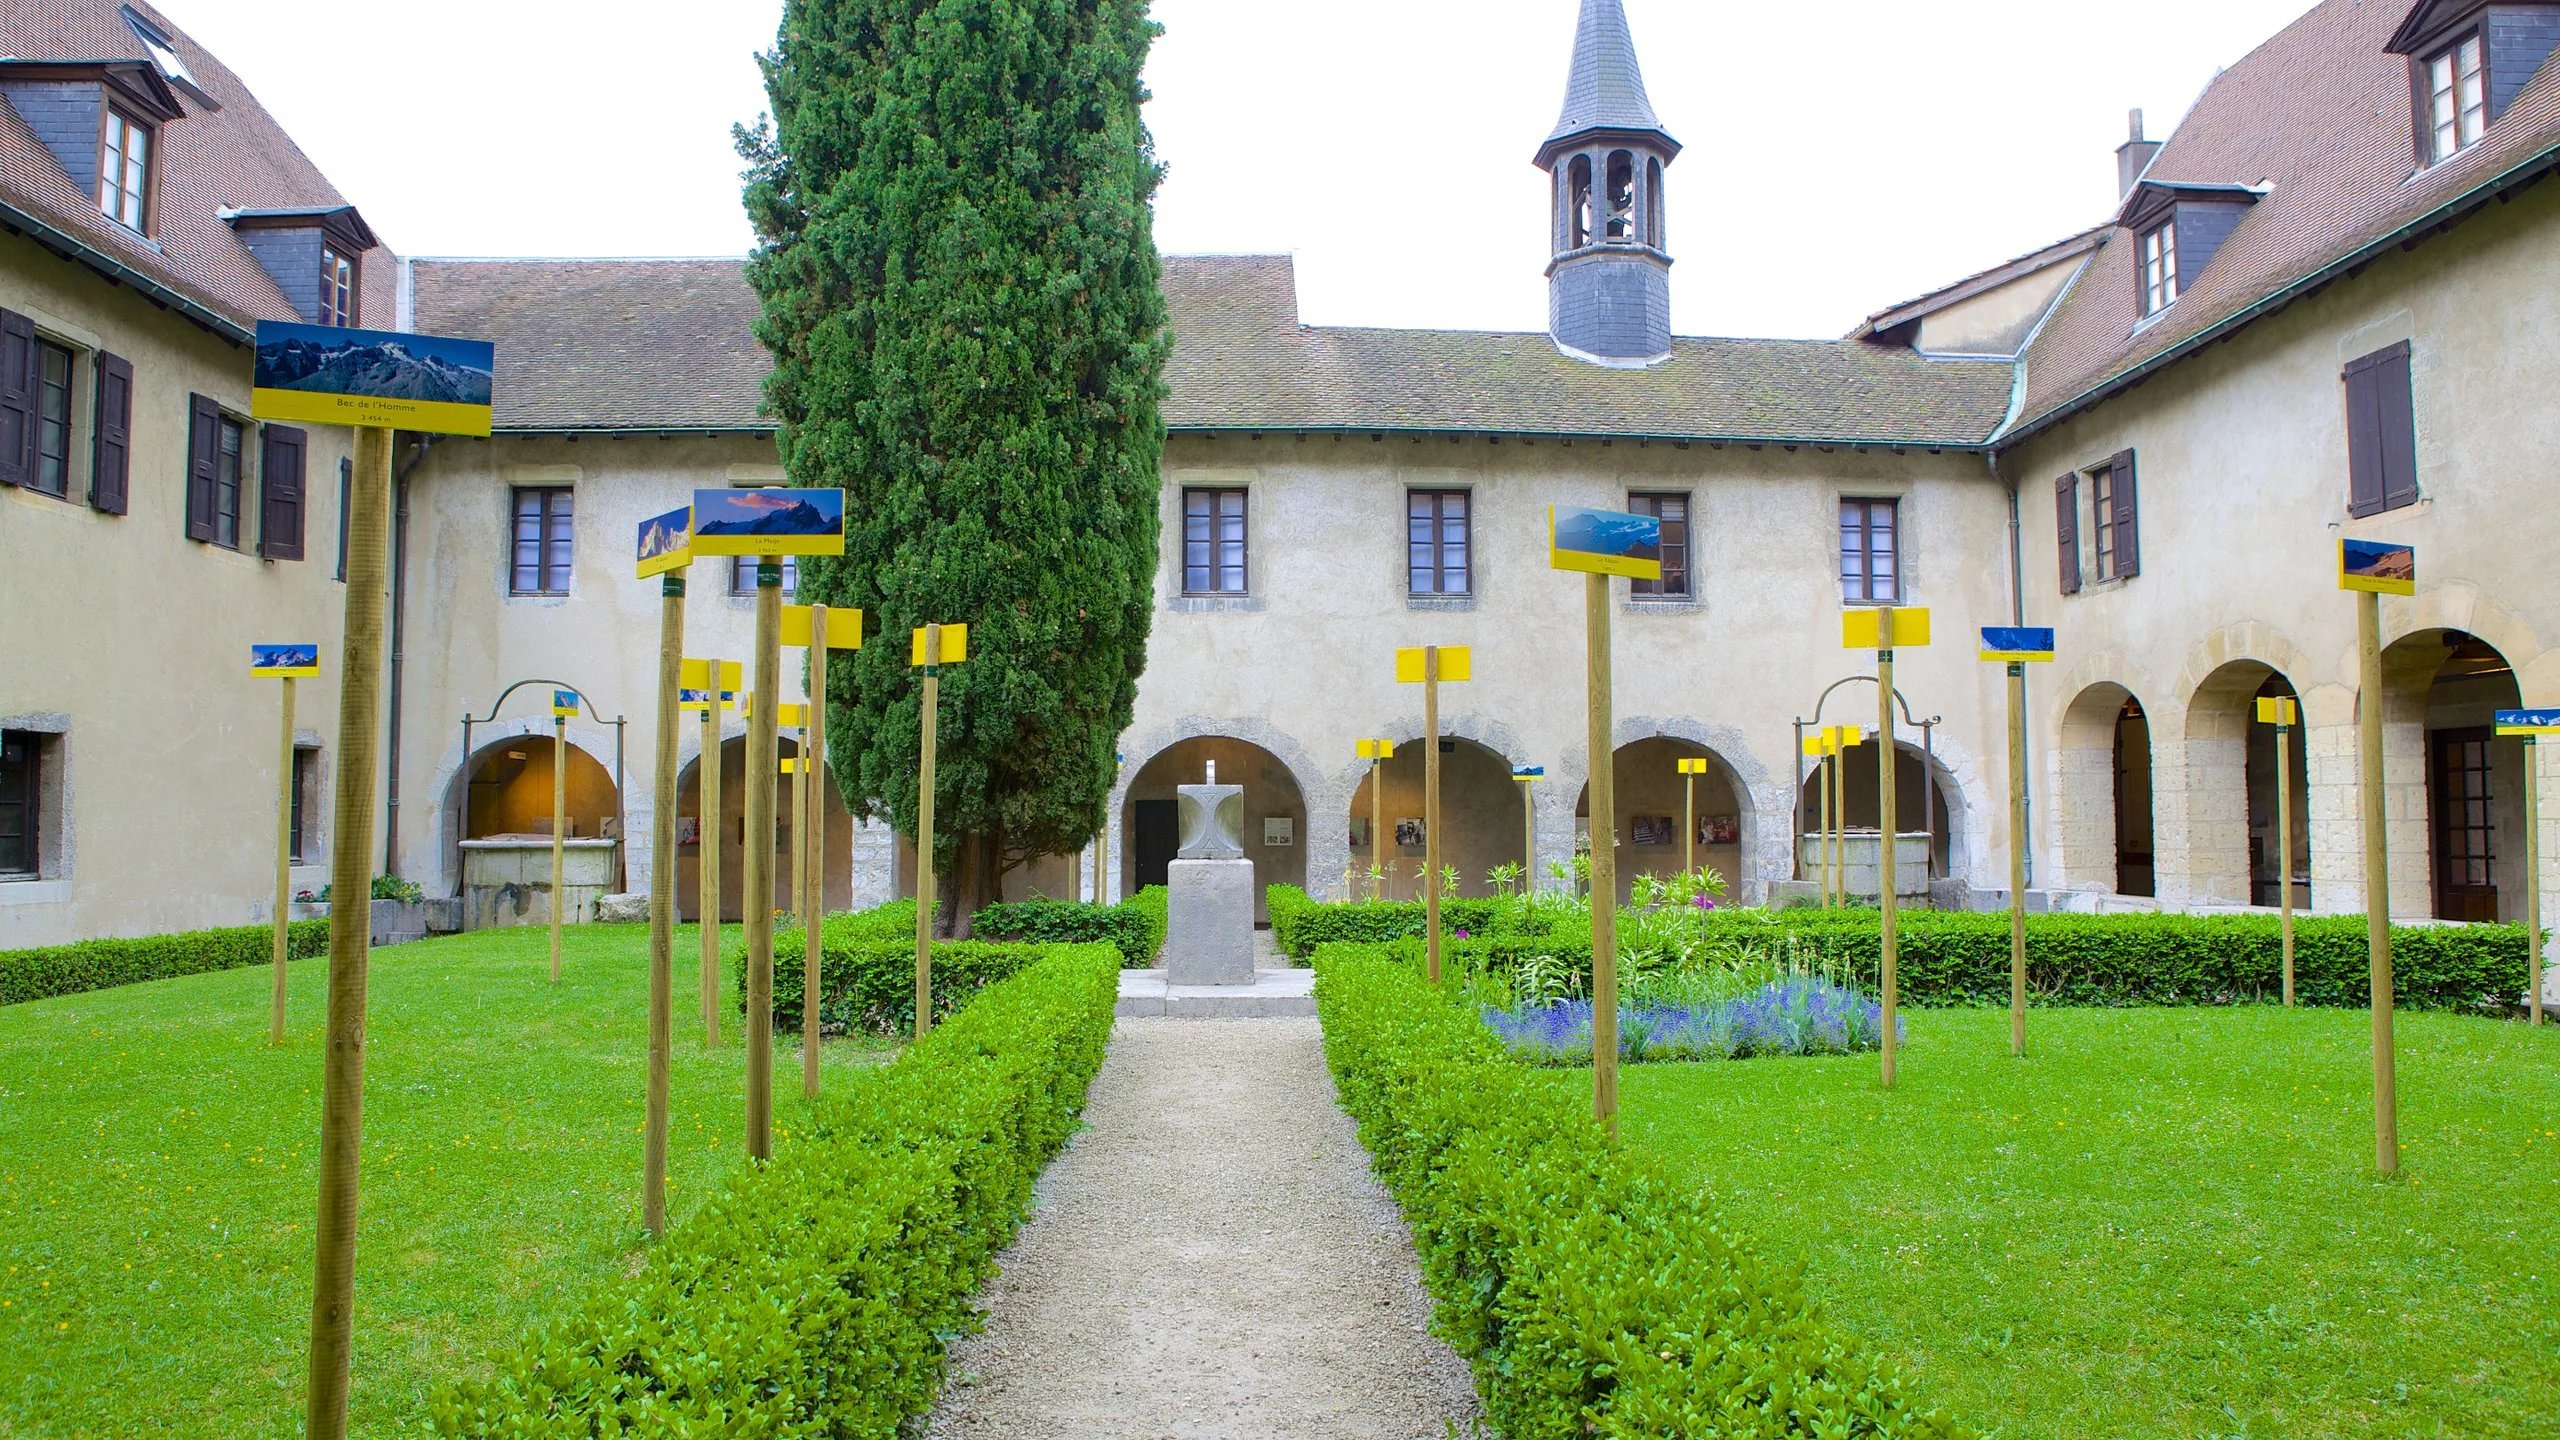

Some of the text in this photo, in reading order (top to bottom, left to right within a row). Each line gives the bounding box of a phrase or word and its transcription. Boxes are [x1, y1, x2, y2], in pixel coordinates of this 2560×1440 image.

[337, 398, 416, 412] Bec de l'Homme
